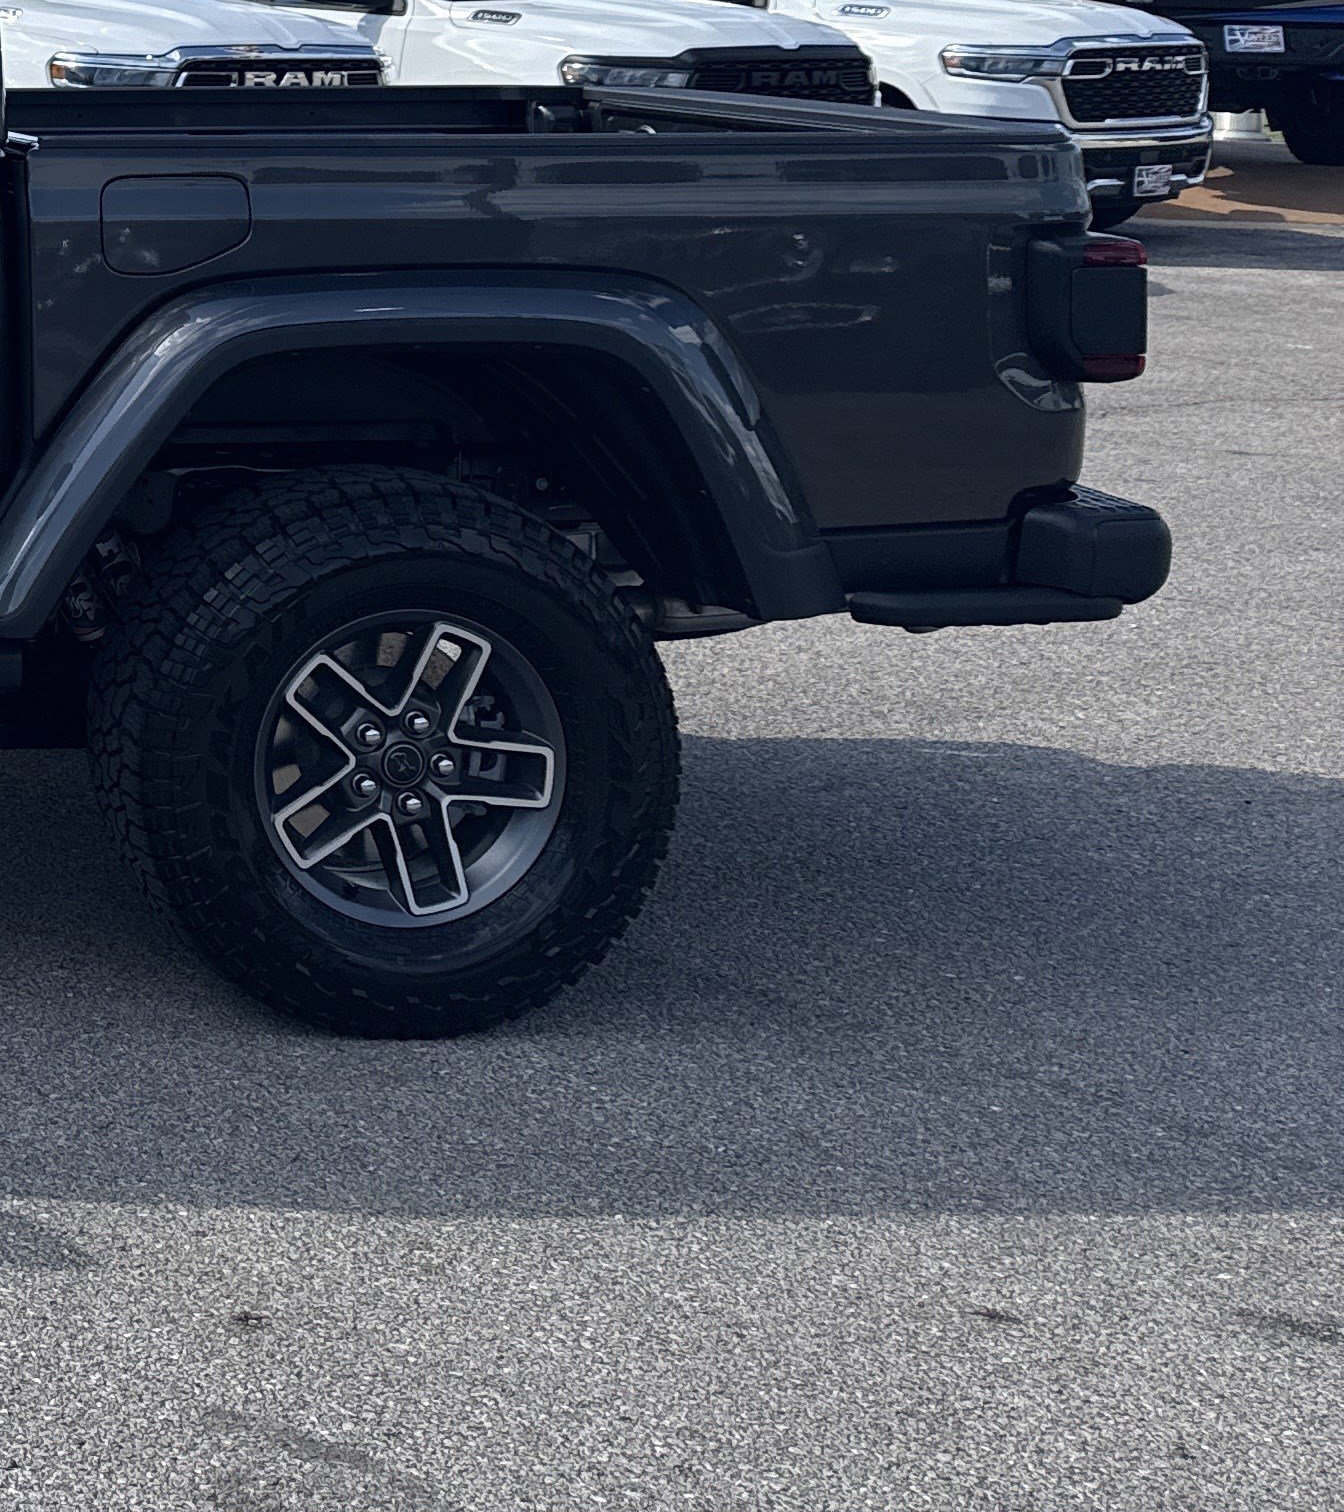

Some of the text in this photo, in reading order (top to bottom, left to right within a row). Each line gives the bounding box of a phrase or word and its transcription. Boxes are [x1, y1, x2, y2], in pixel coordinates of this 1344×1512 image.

[1115, 55, 1185, 71] RAM
[244, 71, 343, 86] RAM
[752, 71, 838, 86] RAM
